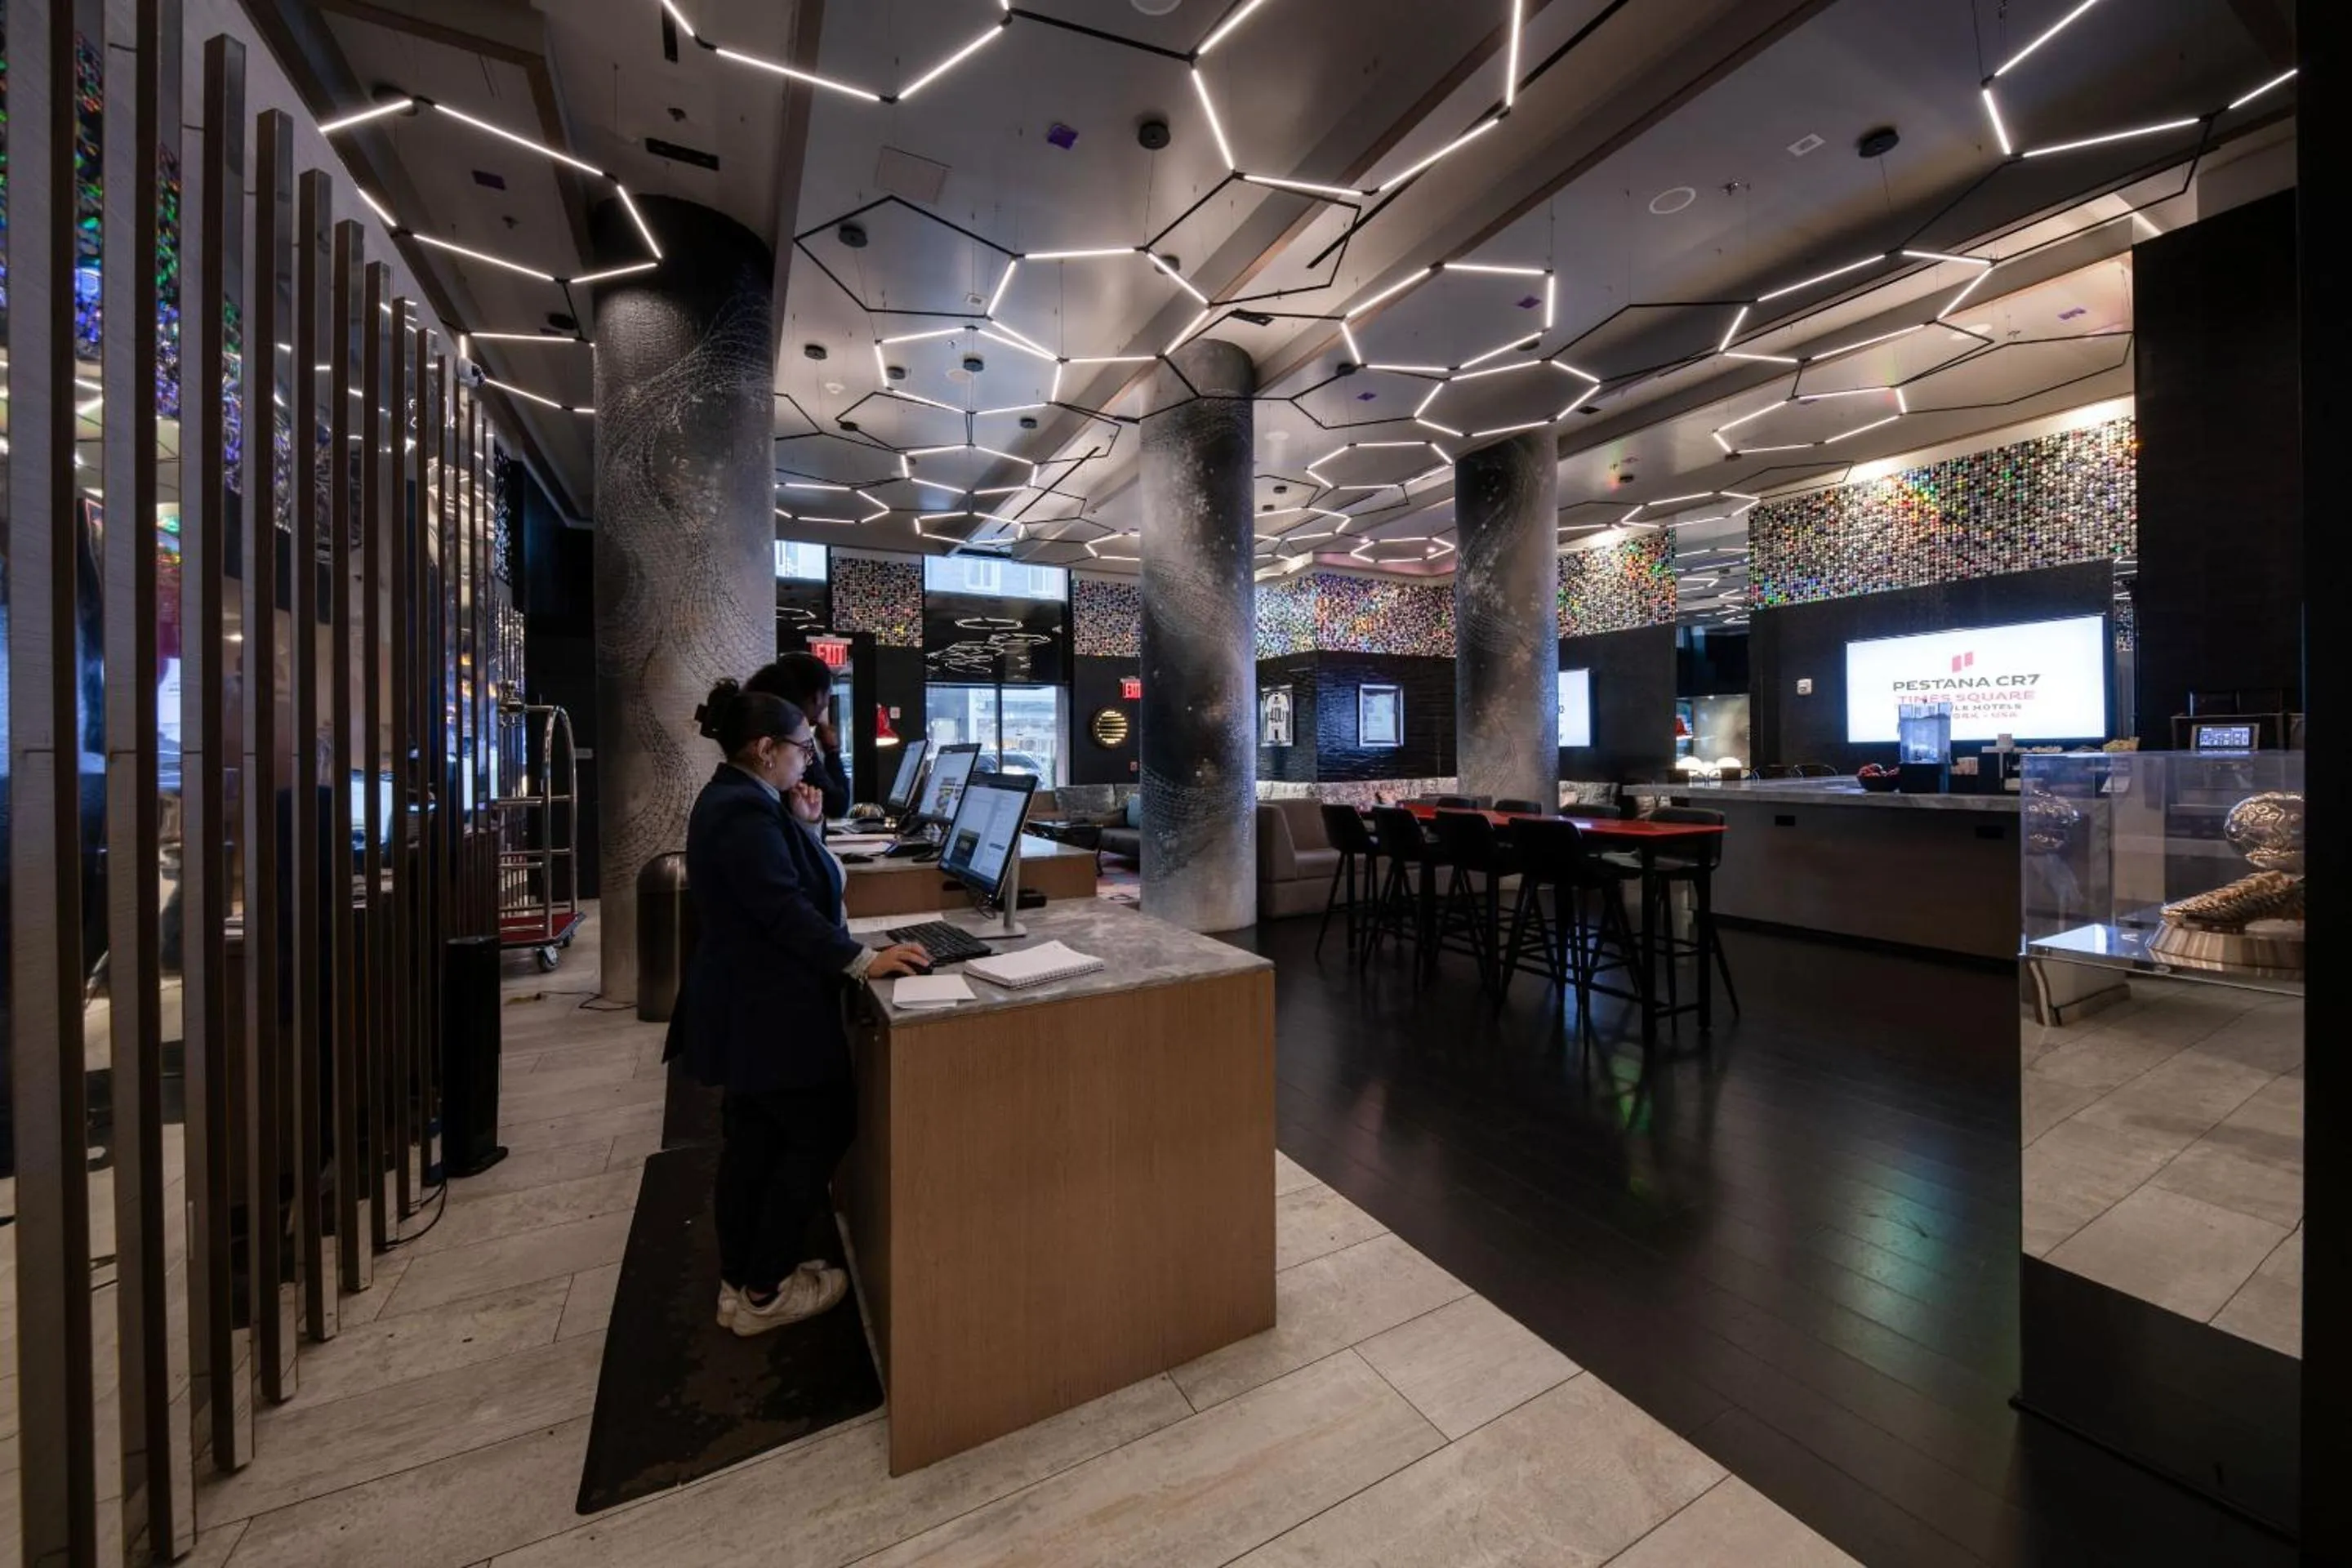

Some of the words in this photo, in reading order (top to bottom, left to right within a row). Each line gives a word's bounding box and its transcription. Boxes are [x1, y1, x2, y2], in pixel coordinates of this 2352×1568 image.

[817, 644, 844, 663] EXIT
[1892, 676, 1991, 692] PESTANA
[1995, 674, 2041, 687] CR7
[1896, 693, 1951, 704] TIMES
[1956, 690, 2035, 703] SQUARE
[1972, 703, 2022, 711] HOTELS
